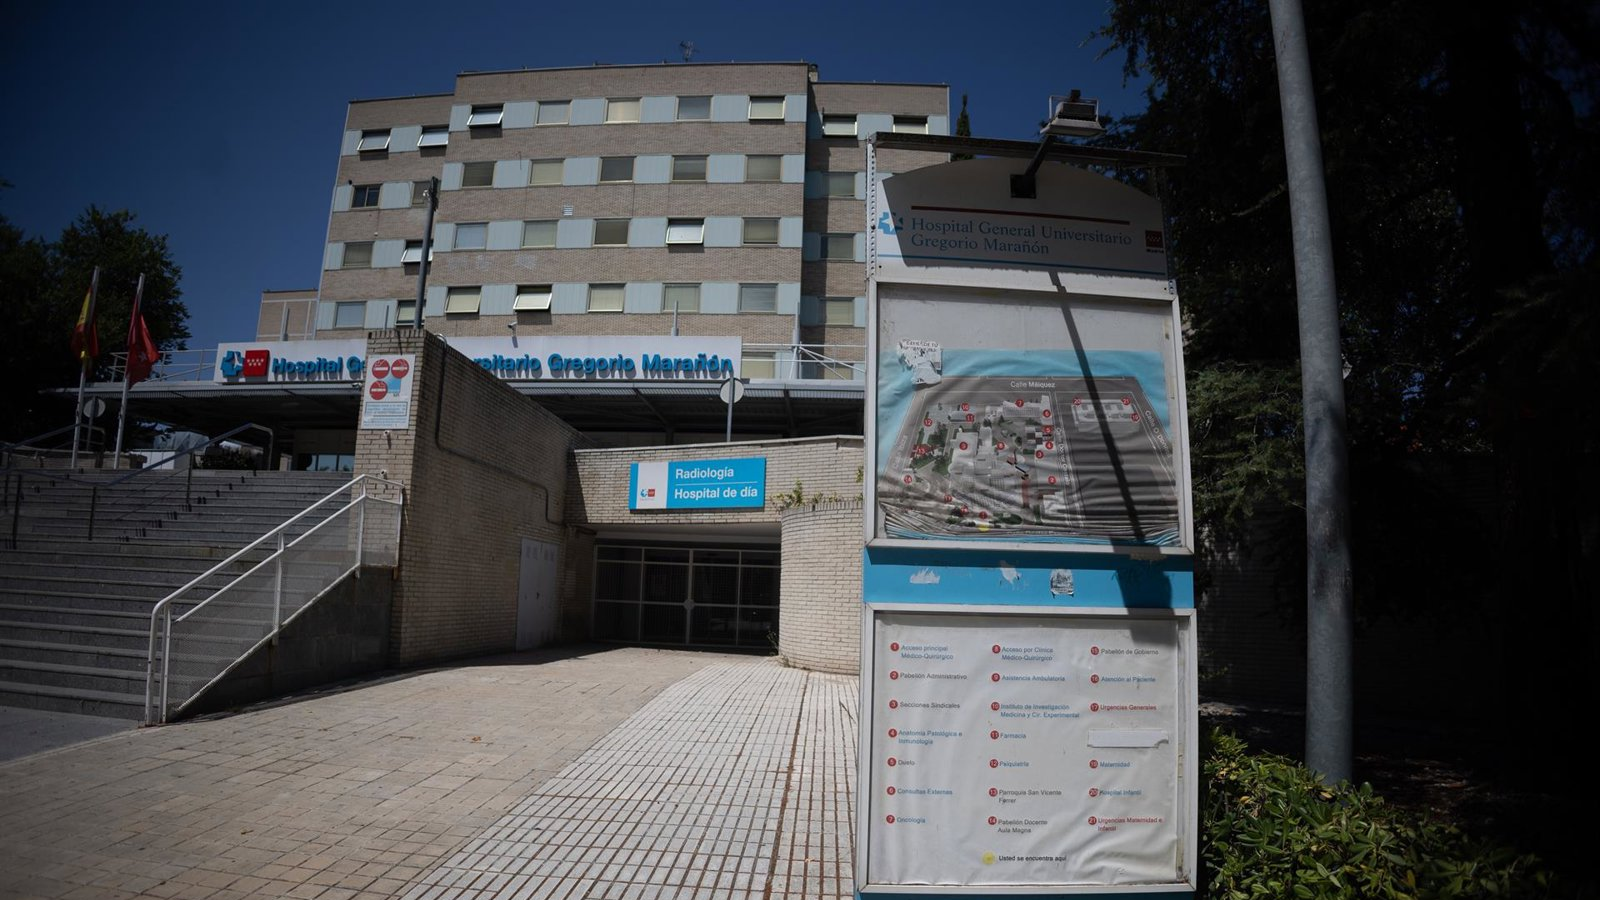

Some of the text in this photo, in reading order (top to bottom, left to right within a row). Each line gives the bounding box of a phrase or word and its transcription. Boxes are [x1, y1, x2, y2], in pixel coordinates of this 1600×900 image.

[911, 218, 1132, 245] Hospital General Universitario
[911, 233, 1049, 254] Gregorio Marañón
[272, 356, 344, 377] Hospital
[548, 353, 635, 374] Gregorio
[642, 353, 733, 372] Marañón
[676, 466, 734, 480] Radiología
[674, 486, 758, 500] Hospital de día
